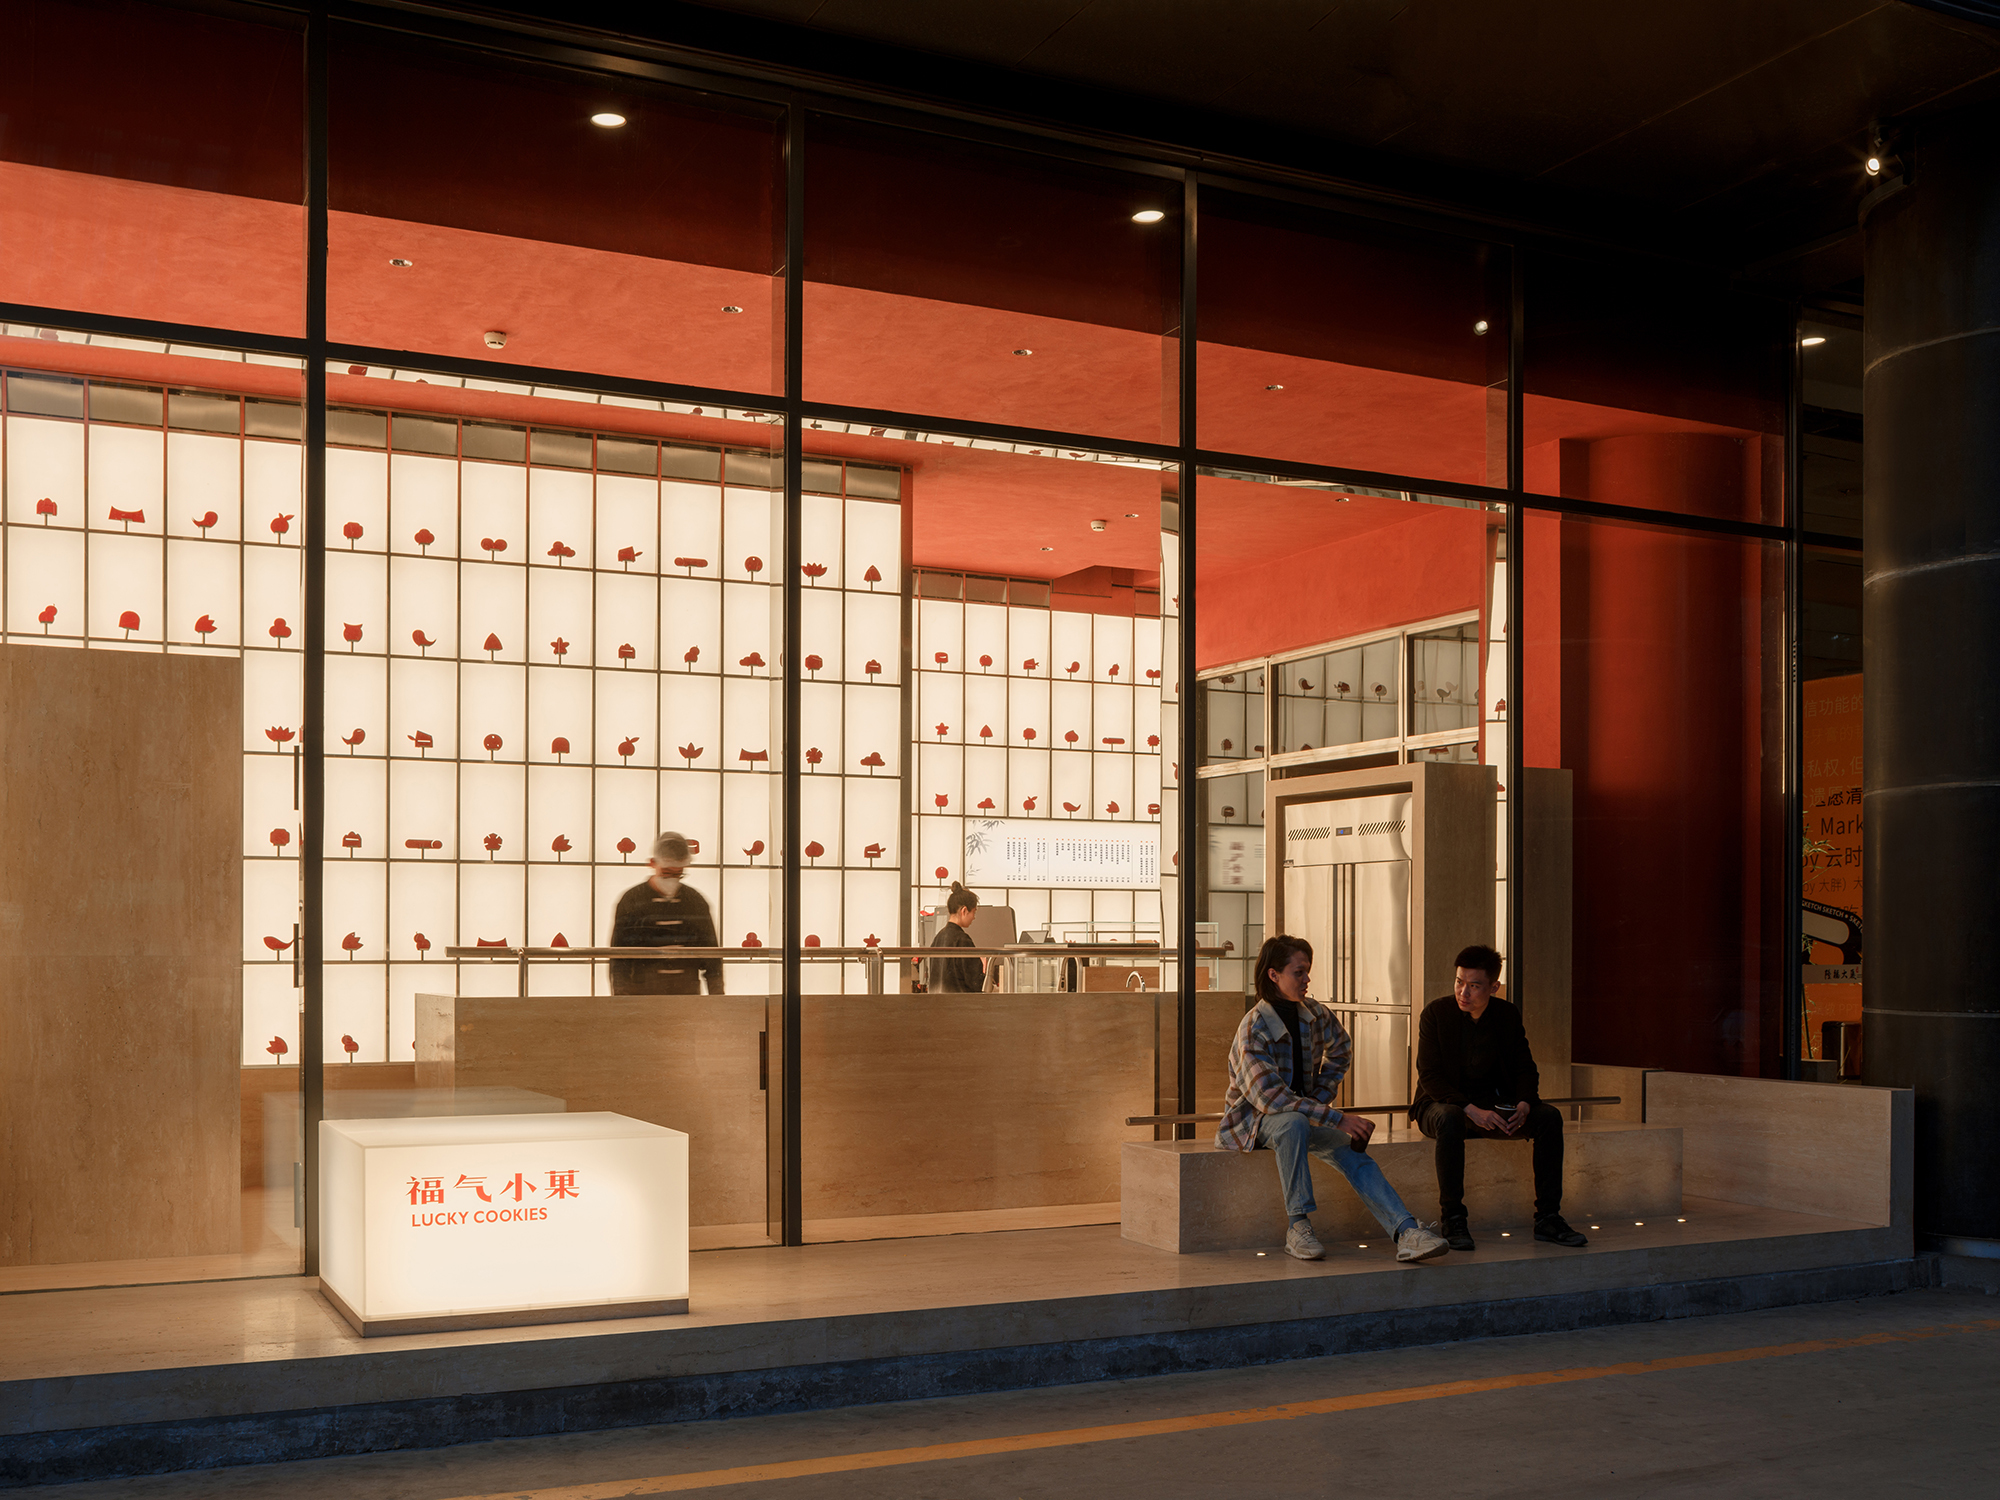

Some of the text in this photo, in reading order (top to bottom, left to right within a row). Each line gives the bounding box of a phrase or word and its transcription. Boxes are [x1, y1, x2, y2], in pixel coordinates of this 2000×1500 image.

[1803, 755, 1863, 779] 私权，但
[1822, 906, 1844, 918] SKETCH
[405, 1169, 580, 1206] 福气小菓
[412, 1207, 548, 1227] LUCKY COOKIES
